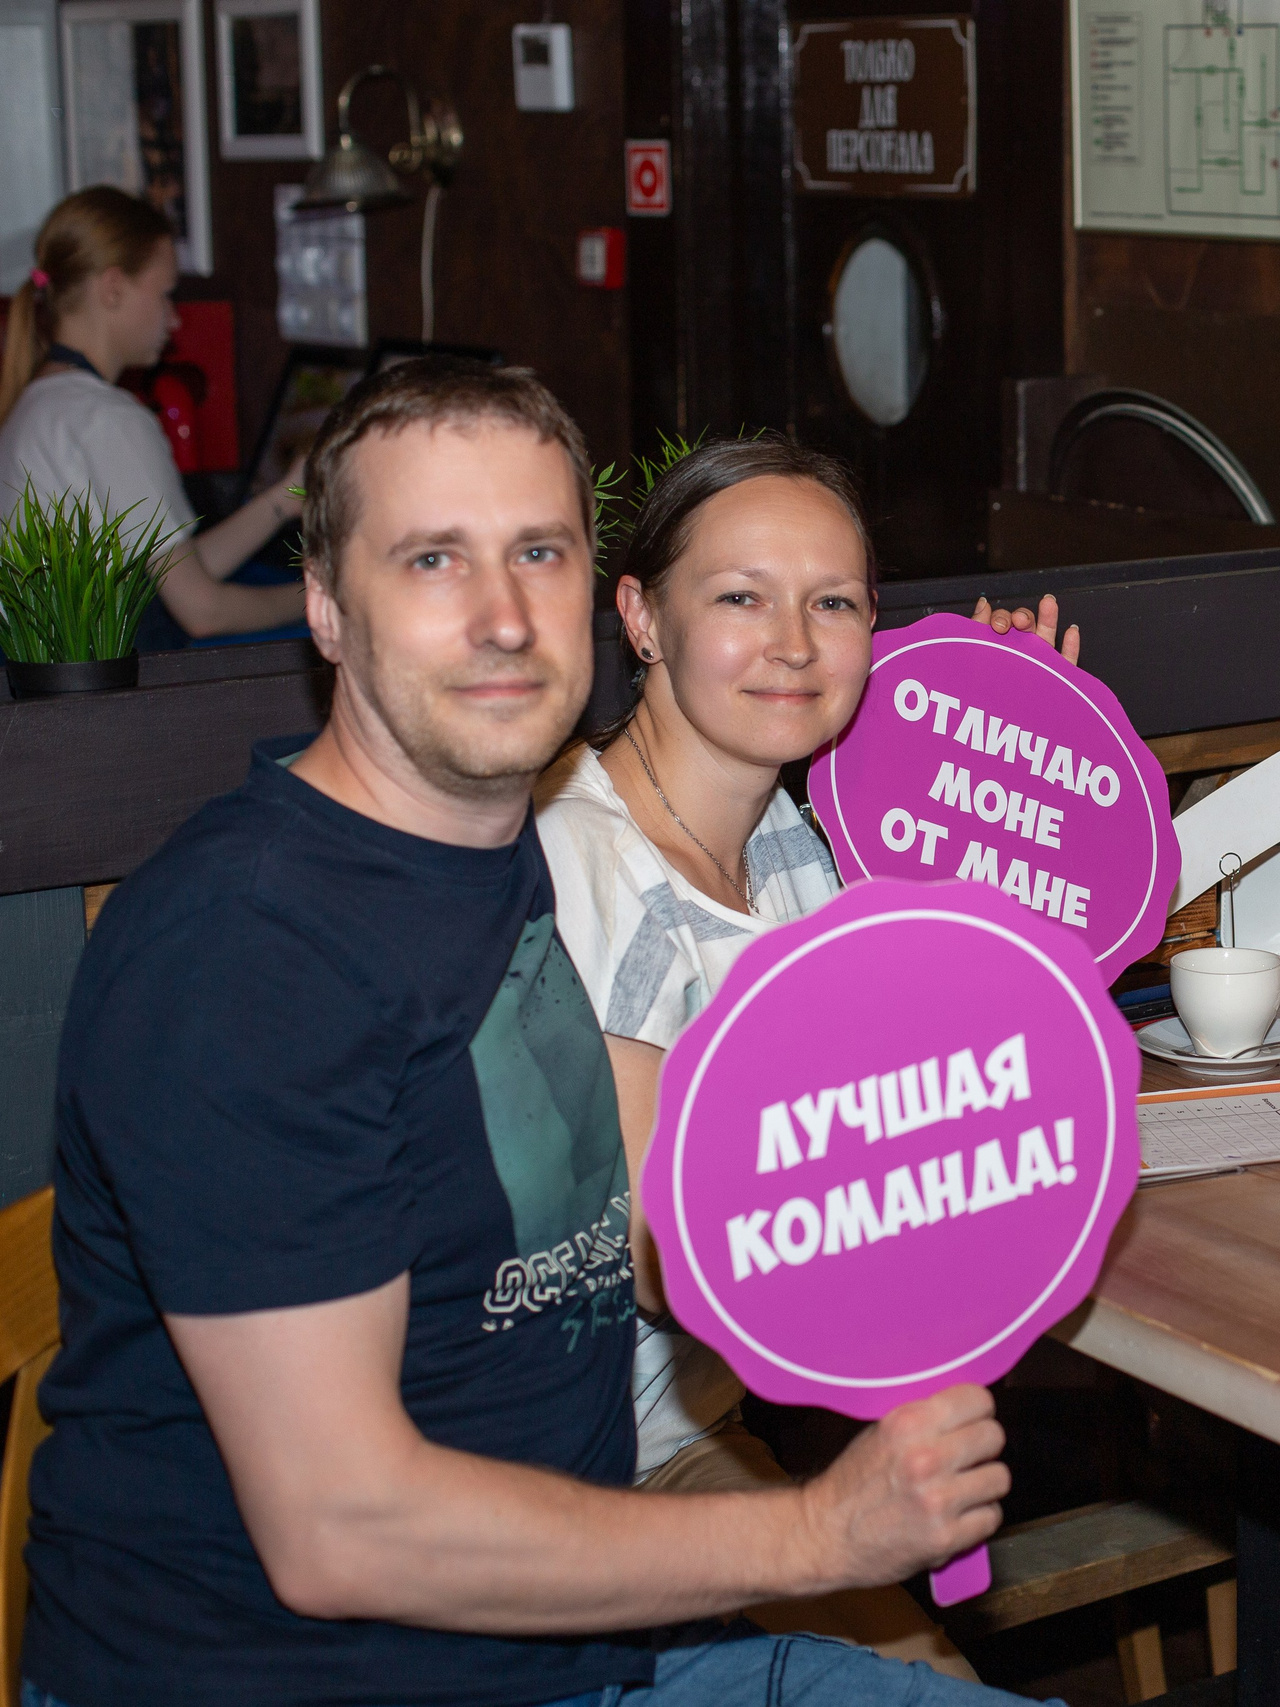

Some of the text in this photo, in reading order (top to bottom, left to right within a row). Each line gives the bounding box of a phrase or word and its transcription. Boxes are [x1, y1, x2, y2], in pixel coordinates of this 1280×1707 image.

[894, 678, 1121, 808] ОТЛИЧАЮ
[928, 761, 1064, 850] МОНЕ
[880, 807, 1091, 929] ОТ МАНЕ
[756, 1033, 1032, 1174] ЛУЧШАЯ
[725, 1117, 1078, 1283] КОМАНДА!
